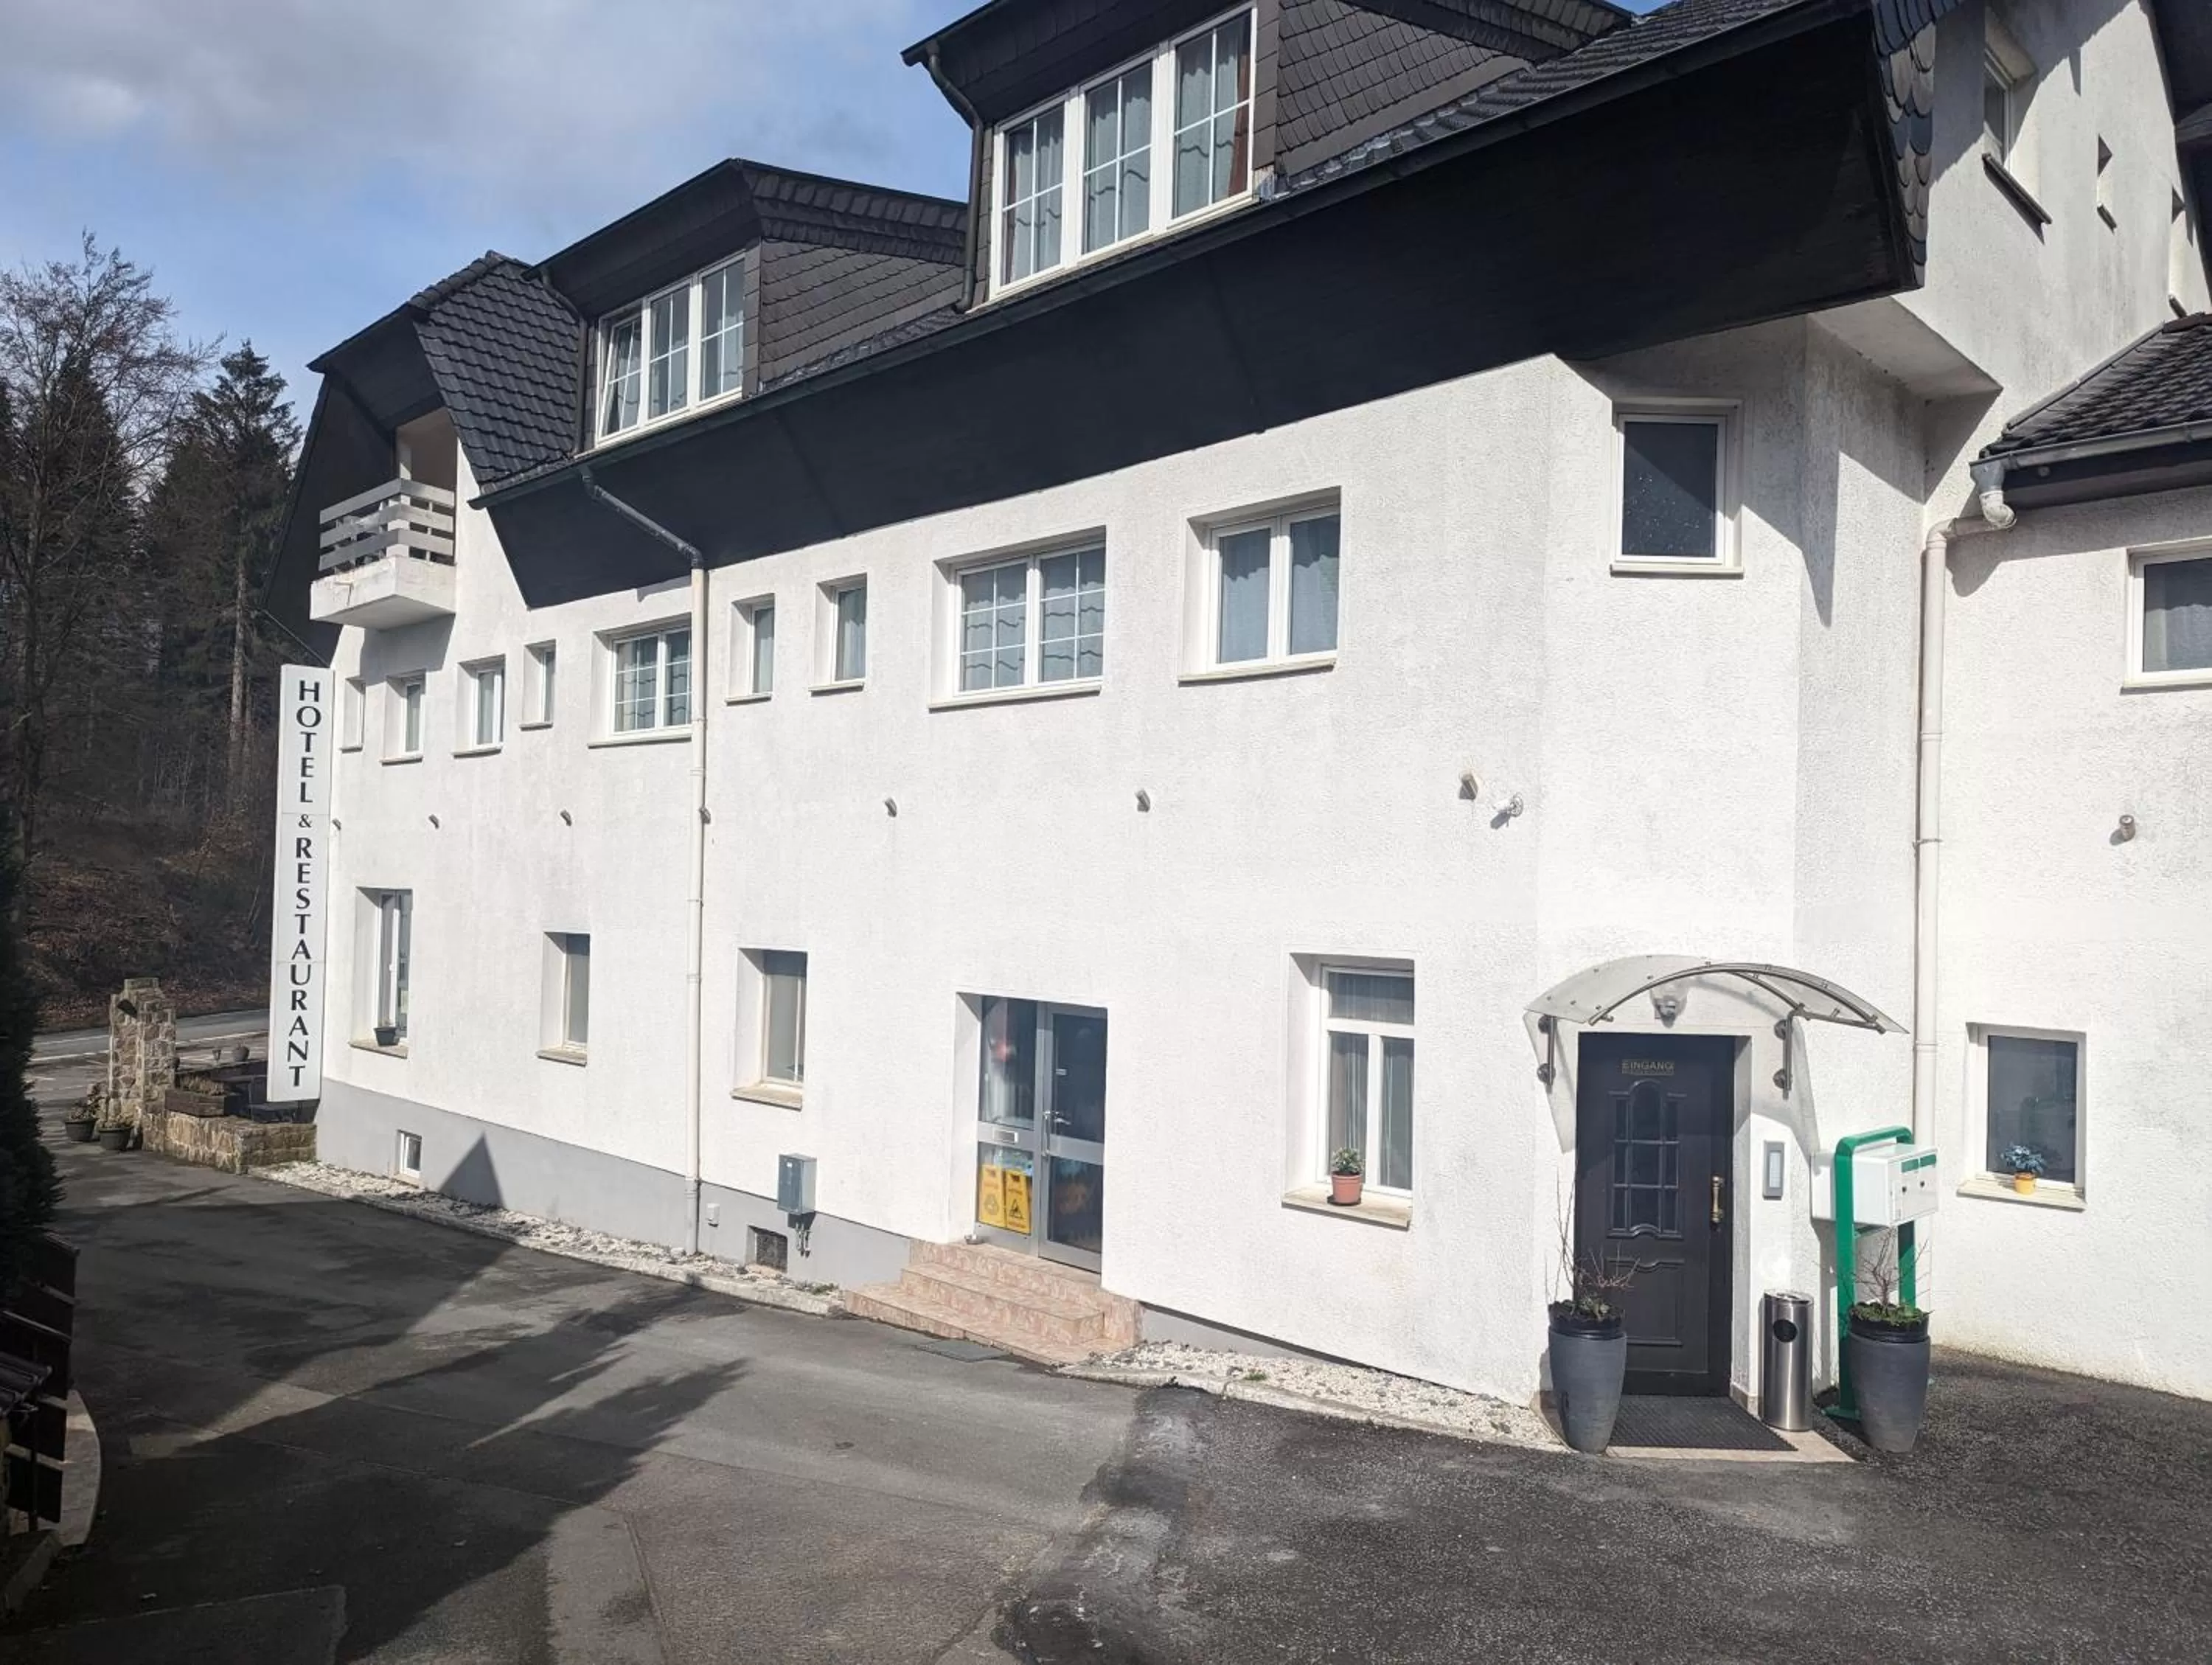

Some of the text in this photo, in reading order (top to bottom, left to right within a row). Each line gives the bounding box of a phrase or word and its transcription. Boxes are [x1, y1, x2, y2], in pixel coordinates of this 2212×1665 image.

[288, 680, 321, 1086] HOTEL & RESTAURANT
[1622, 1060, 1674, 1071] EINGANG
